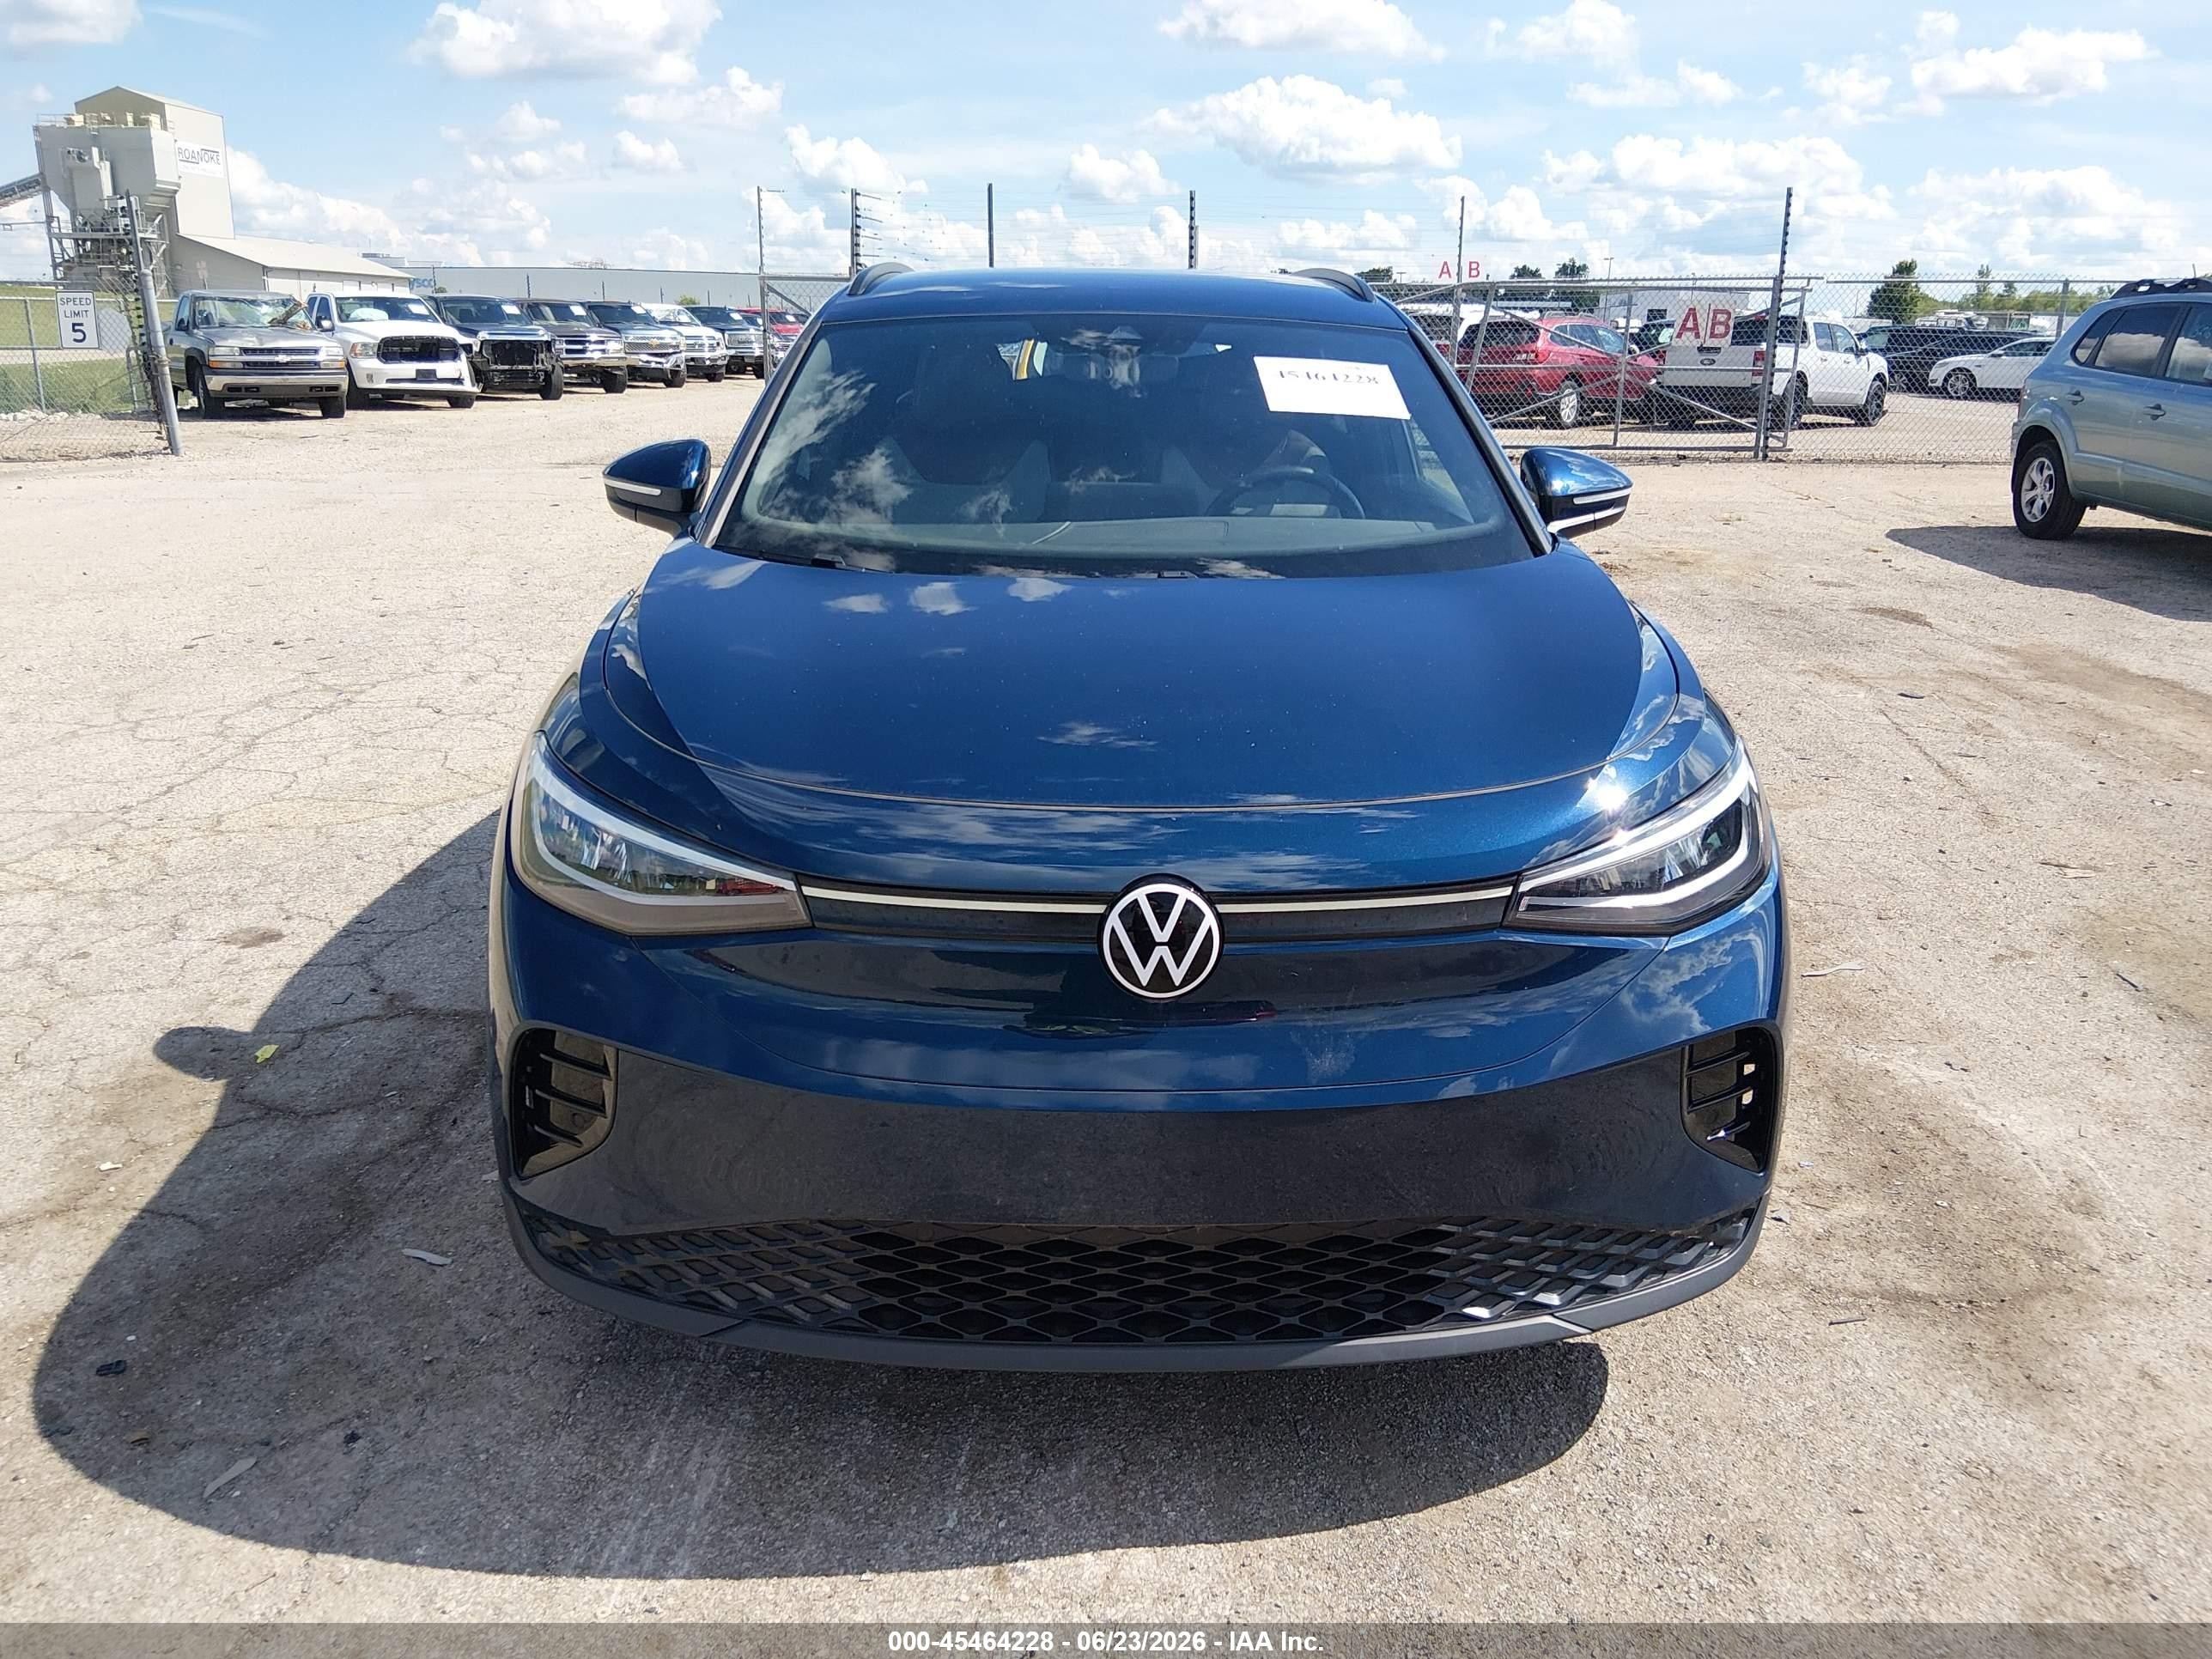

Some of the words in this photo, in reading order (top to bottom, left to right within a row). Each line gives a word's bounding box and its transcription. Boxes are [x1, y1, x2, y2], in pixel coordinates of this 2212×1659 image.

[177, 147, 221, 165] ROANOKE
[1438, 261, 1451, 278] A
[1468, 261, 1480, 278] B
[59, 297, 92, 306] SPEED
[64, 309, 90, 319] LIMIT
[1675, 308, 1701, 339] A
[1709, 308, 1732, 339] B
[71, 322, 87, 343] 5
